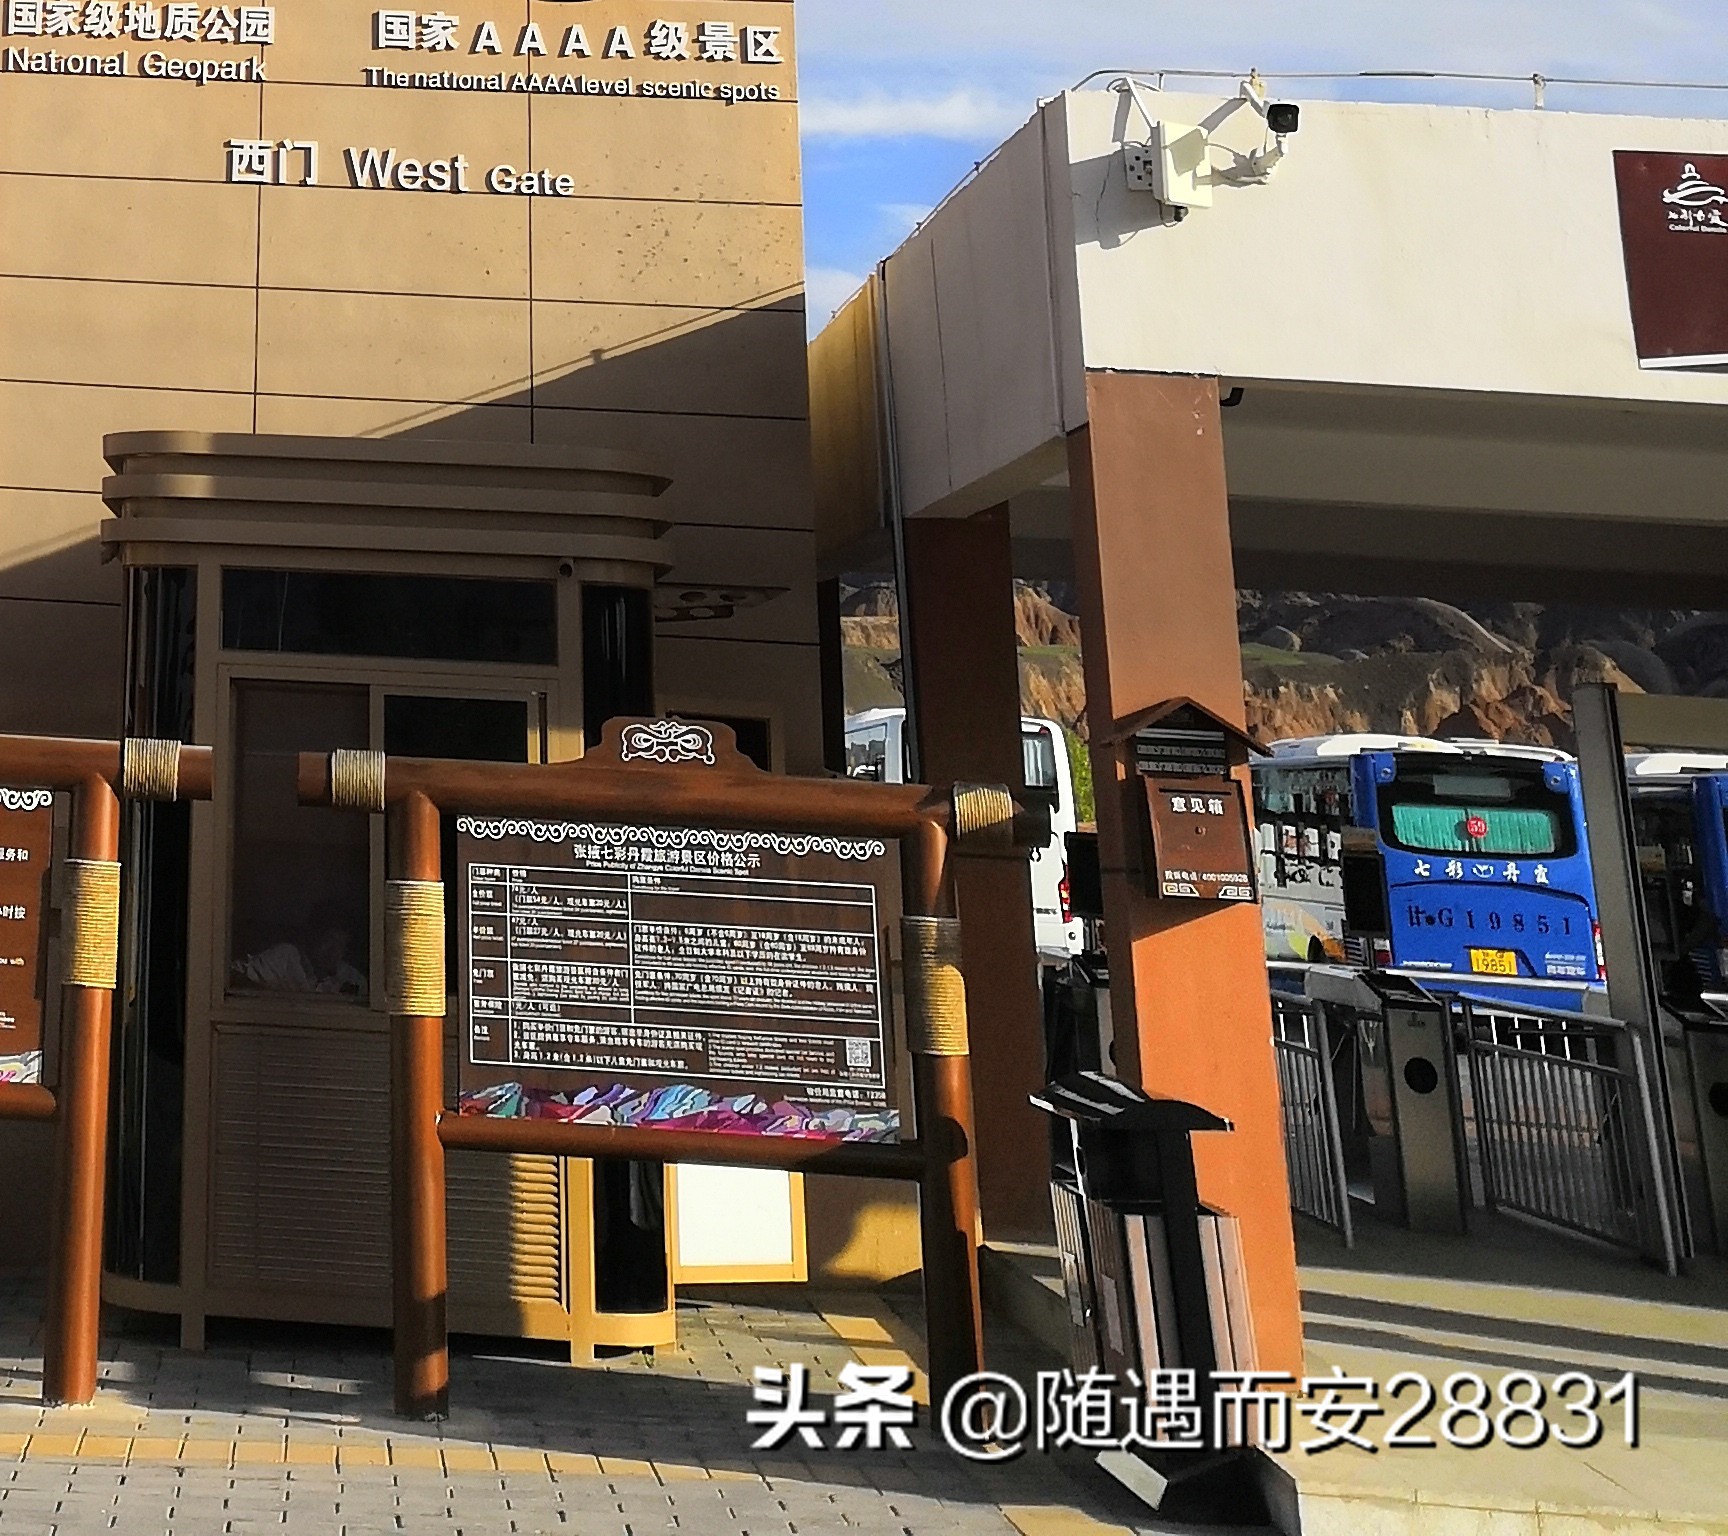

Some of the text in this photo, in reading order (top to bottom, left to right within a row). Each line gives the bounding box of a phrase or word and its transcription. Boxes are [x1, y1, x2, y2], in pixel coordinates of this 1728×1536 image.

[8, 46, 268, 85] National Geopark
[581, 75, 634, 96] level
[642, 77, 712, 98] scenic
[720, 80, 782, 104] spots
[229, 137, 576, 196] 西门 West Gate
[1171, 796, 1225, 815] 意见箱
[1475, 958, 1513, 973] 19851
